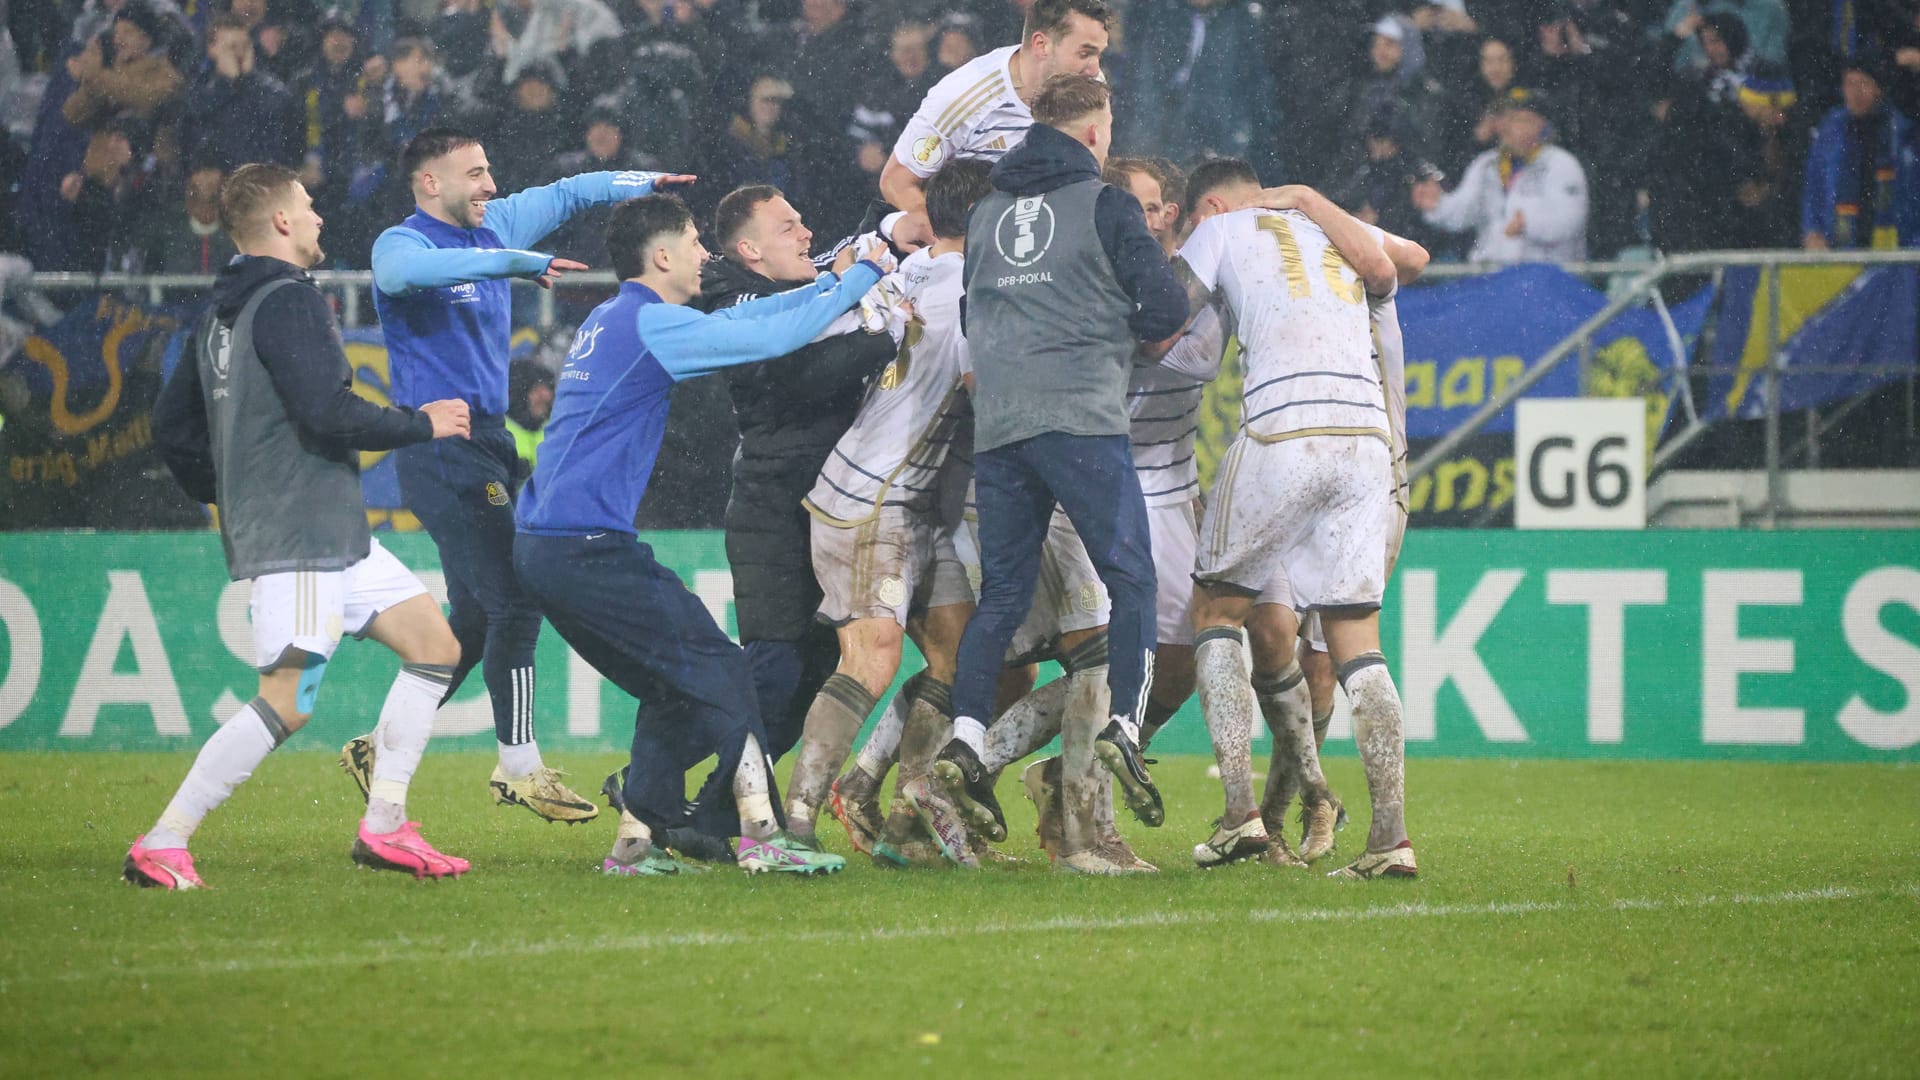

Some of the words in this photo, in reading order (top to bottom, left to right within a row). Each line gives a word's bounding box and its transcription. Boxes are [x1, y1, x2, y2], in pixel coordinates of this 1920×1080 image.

[997, 271, 1053, 288] DFB-POKAL
[1528, 436, 1630, 509] G6
[1250, 565, 1920, 750] KTES
